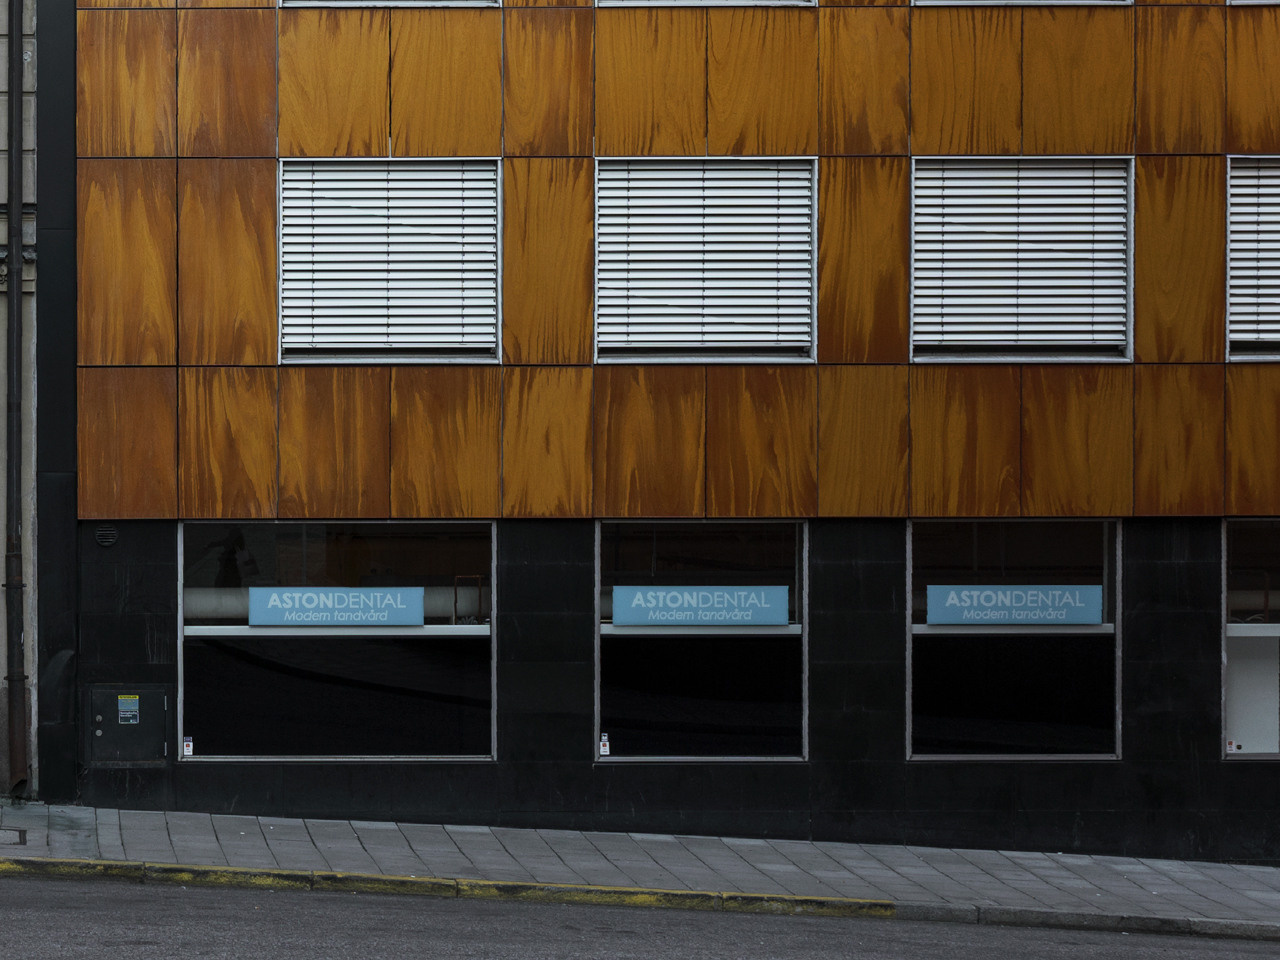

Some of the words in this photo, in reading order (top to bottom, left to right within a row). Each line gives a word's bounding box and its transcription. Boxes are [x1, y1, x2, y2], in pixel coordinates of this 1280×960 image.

[267, 592, 407, 609] ASTONDENTAL
[631, 591, 771, 608] ASTONDENTAL
[945, 590, 1086, 607] ASTONDENTAL
[284, 610, 331, 621] Modern
[333, 609, 389, 621] tandvård
[648, 609, 695, 620] Modern
[697, 608, 753, 620] tandvård
[962, 608, 1010, 619] Modern
[1011, 607, 1067, 619] tandvård
